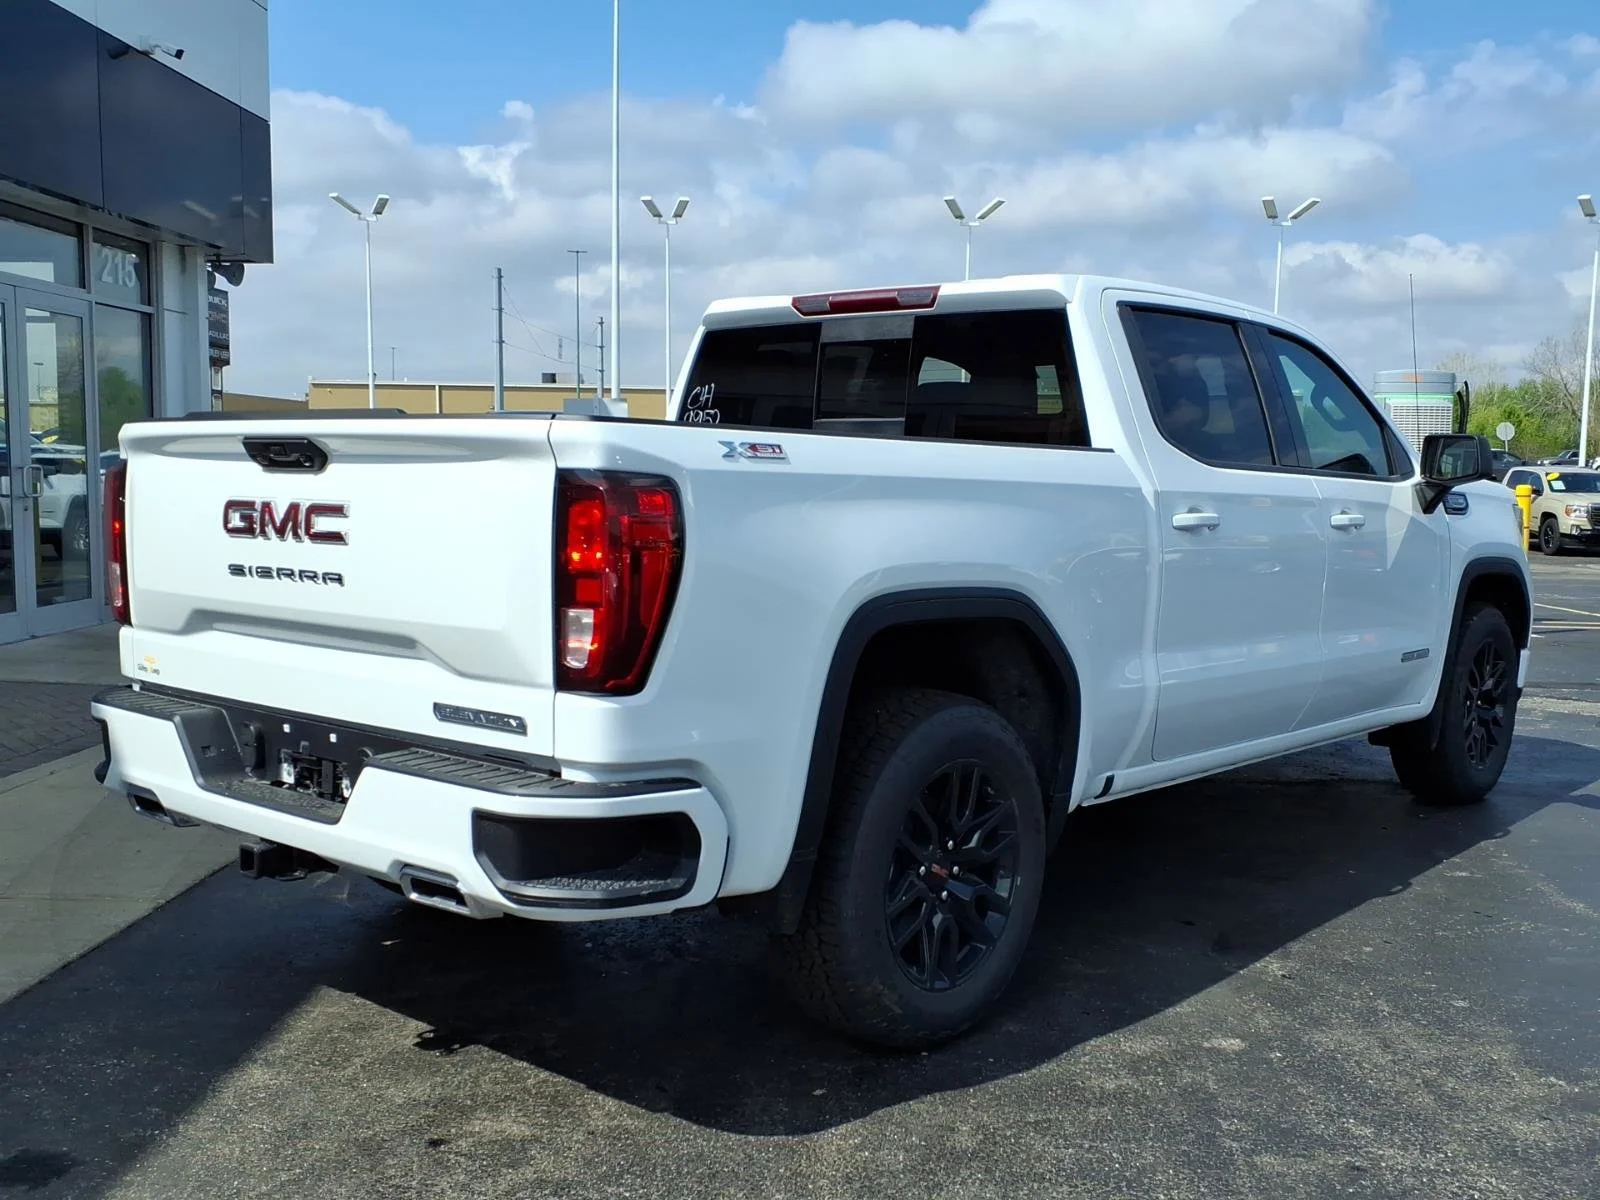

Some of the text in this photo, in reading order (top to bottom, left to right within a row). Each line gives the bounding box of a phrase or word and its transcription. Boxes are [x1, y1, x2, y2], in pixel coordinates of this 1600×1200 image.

[101, 247, 139, 288] 215
[208, 295, 228, 308] UICK
[208, 330, 230, 341] ADILLAC
[687, 382, 715, 409] CH
[223, 498, 350, 546] GMC
[228, 563, 345, 587] SIERRA
